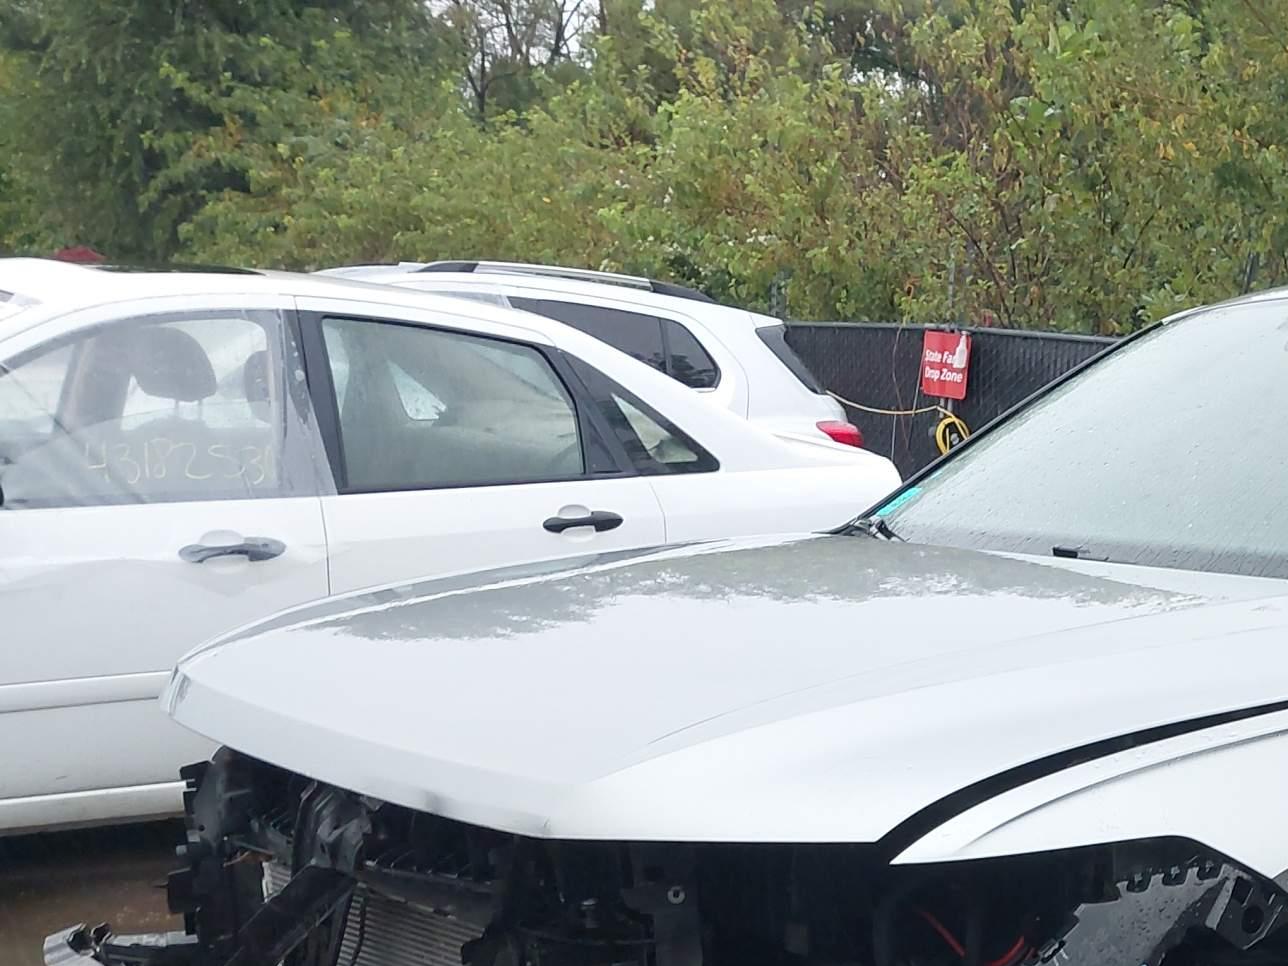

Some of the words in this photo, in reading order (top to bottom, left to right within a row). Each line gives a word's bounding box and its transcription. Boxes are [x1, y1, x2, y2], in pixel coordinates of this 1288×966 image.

[925, 349, 942, 362] State
[925, 366, 940, 382] Drop
[940, 368, 963, 383] Zone
